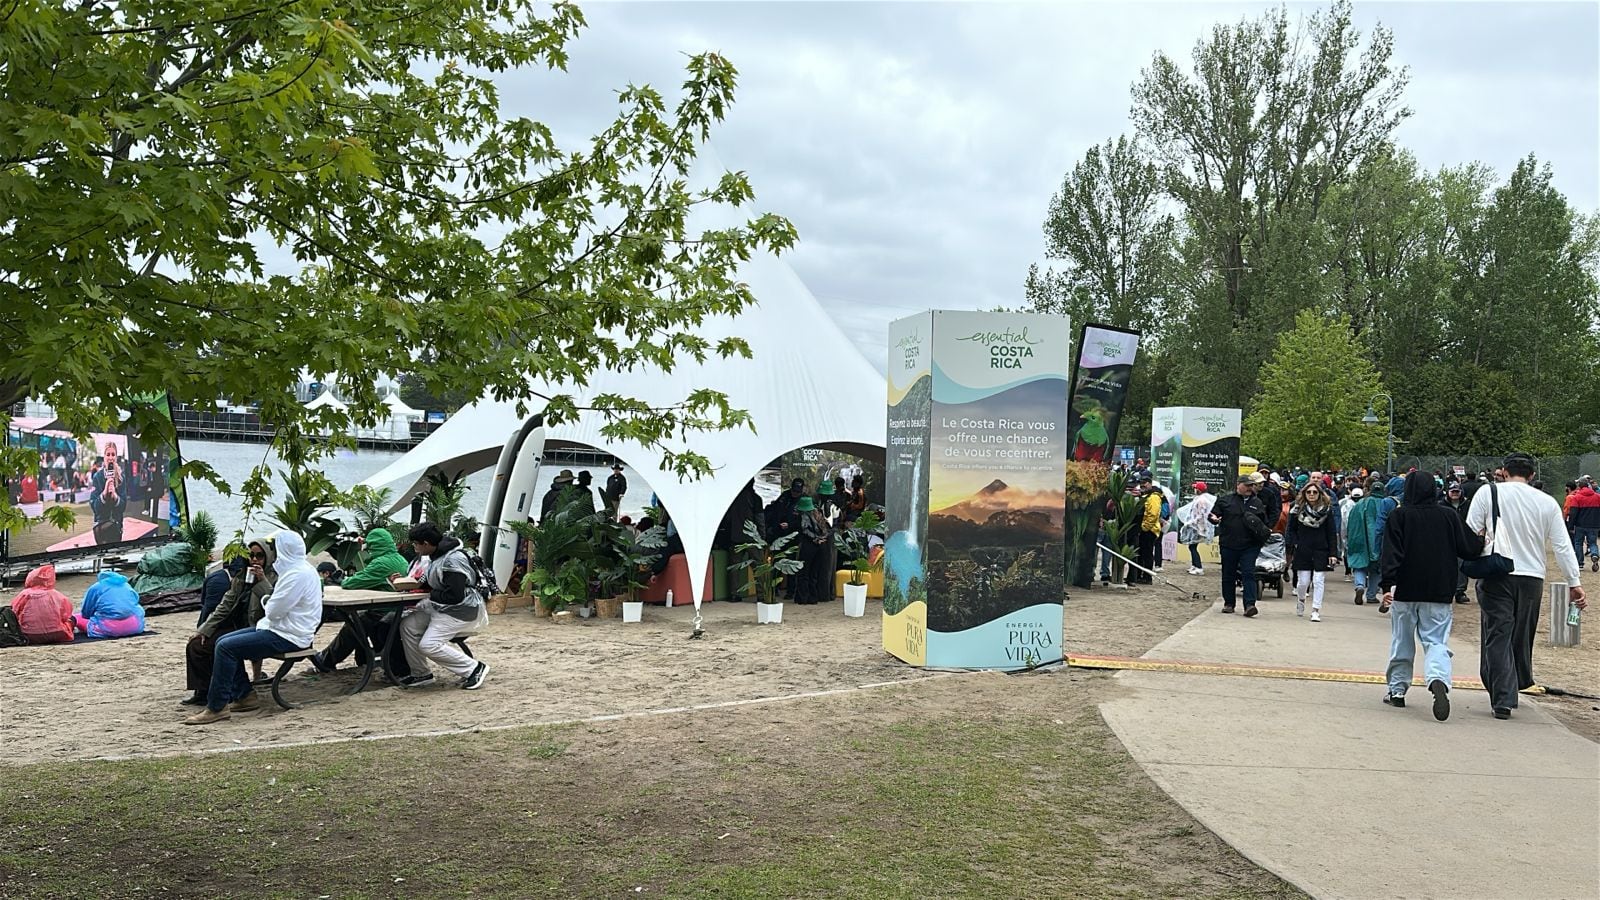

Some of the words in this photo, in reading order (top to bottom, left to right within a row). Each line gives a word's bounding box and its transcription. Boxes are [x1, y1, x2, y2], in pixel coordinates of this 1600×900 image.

[955, 326, 1039, 346] essential
[990, 346, 1033, 357] COSTA
[990, 358, 1022, 368] RICA
[942, 417, 957, 428] Le
[960, 418, 995, 429] Costa
[998, 419, 1024, 430] Rica
[1028, 421, 1055, 431] vous
[948, 432, 977, 443] offre
[981, 435, 1003, 444] une
[1006, 433, 1049, 445] chance
[944, 446, 960, 457] de
[963, 449, 992, 457] vous
[995, 448, 1052, 459] recentrer.
[906, 622, 923, 646] PURA
[1009, 630, 1052, 648] PURA
[1005, 647, 1042, 661] VIDA
